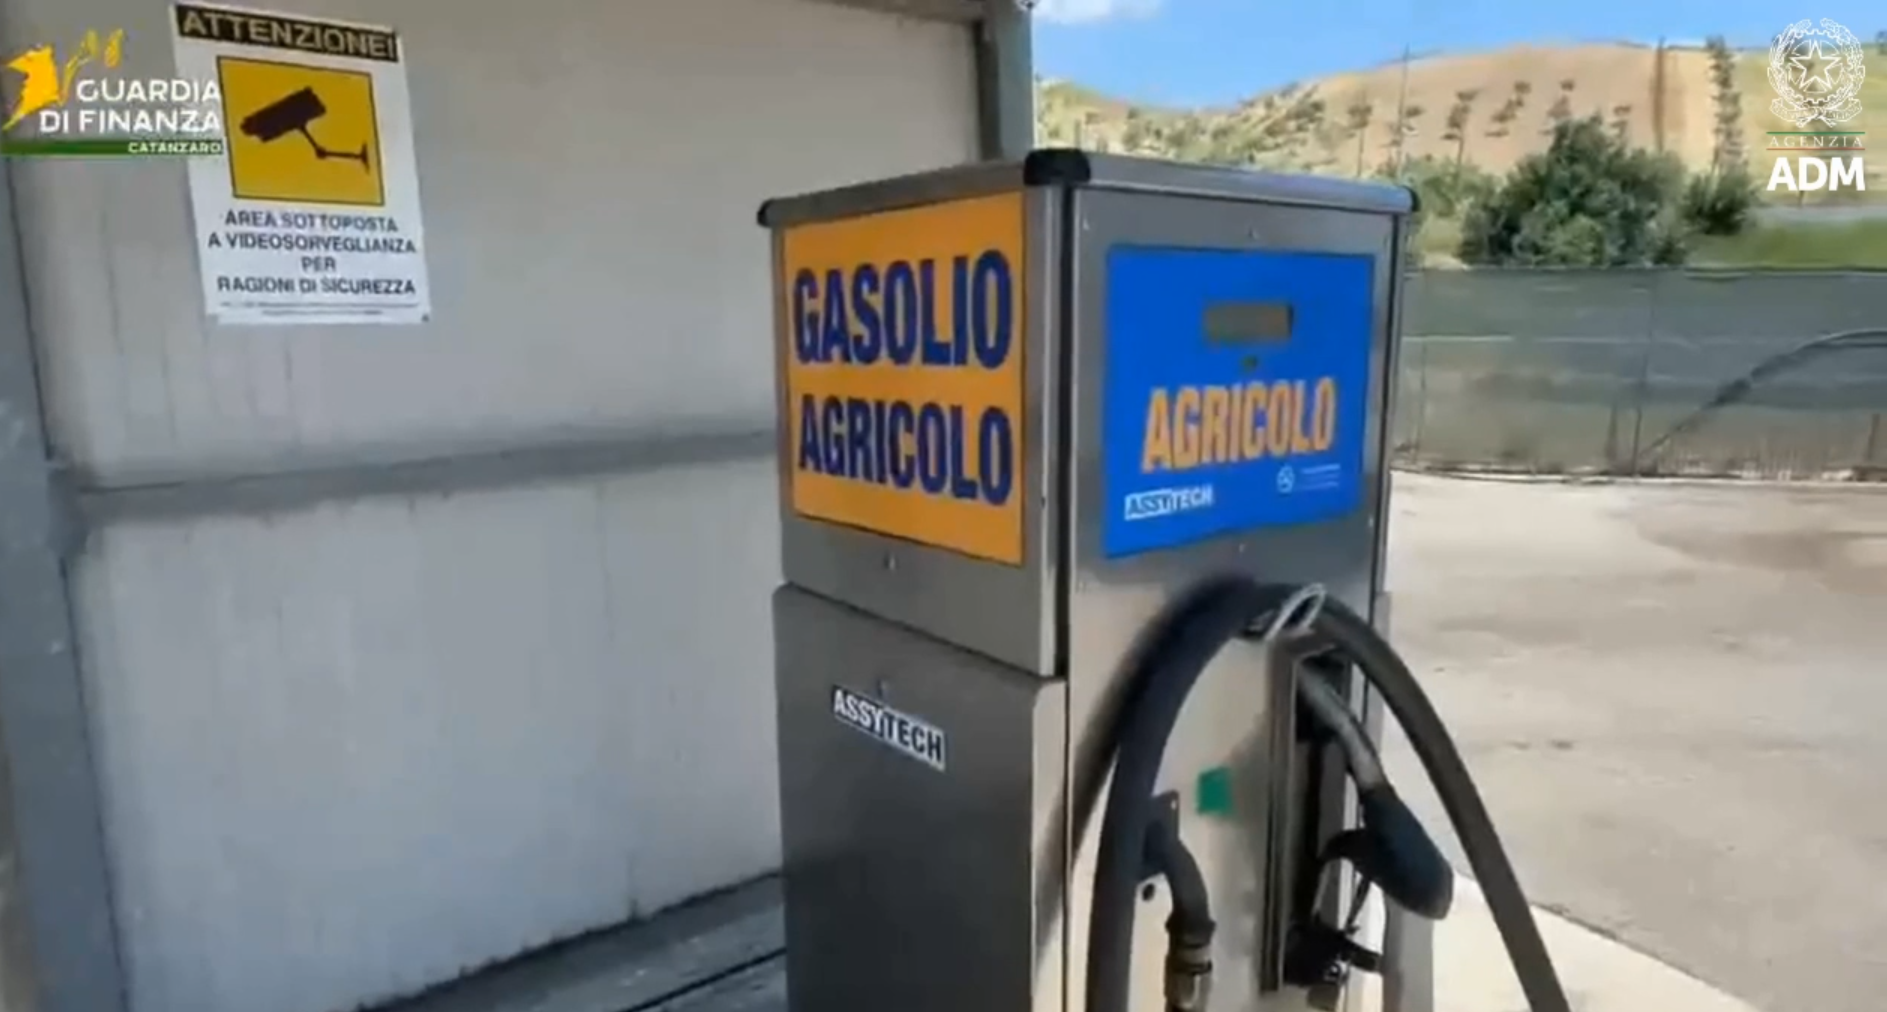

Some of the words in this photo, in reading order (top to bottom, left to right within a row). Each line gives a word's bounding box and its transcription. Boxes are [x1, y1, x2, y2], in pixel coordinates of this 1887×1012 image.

[182, 9, 396, 60] ATTENZIONE!
[208, 232, 221, 248] A
[226, 233, 416, 253] VIDEOSORVEGLIANZA
[225, 209, 277, 227] AREA
[281, 211, 398, 232] SOTTOPOSTA
[217, 277, 295, 293] RAGIONI
[300, 278, 317, 292] DI
[322, 279, 415, 294] SICUREZZA
[301, 256, 336, 272] PER
[793, 249, 1013, 370] GASOLIO
[799, 393, 1013, 506] AGRICOLO
[1142, 377, 1337, 473] AGRICOLO
[834, 689, 943, 763] ASSYTECH
